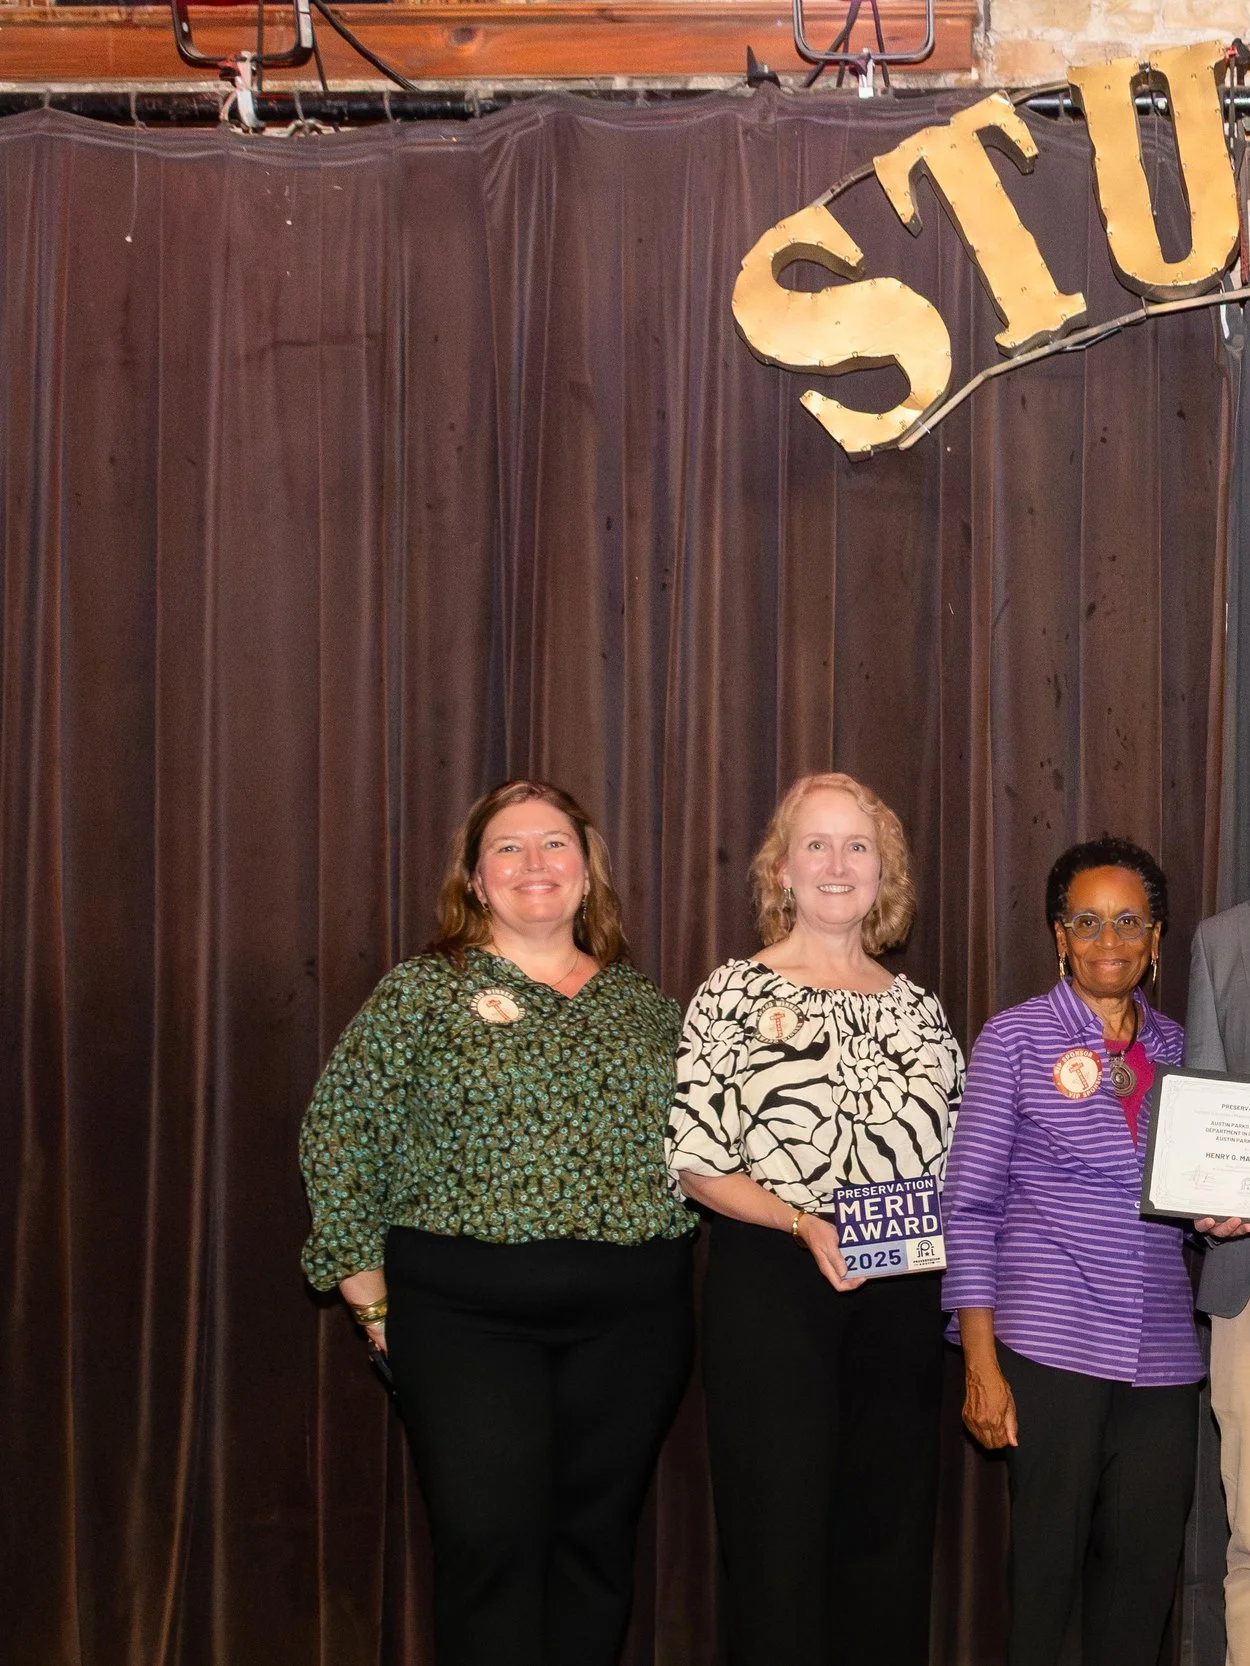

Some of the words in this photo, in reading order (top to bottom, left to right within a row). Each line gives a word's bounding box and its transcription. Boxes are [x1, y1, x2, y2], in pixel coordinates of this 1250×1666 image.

[1061, 1049, 1094, 1063] SPONSOR
[1068, 1091, 1081, 1099] VIP
[1082, 1070, 1103, 1098] SPONSOR
[1205, 1127, 1241, 1136] DEPARTMENT
[1210, 1120, 1231, 1128] AUSTIN
[1230, 1122, 1250, 1130] PARKS
[1205, 1152, 1230, 1160] HENRY
[837, 1179, 934, 1200] PRESERVATION
[839, 1190, 934, 1224] MERIT
[841, 1215, 938, 1244] AWARD
[844, 1249, 902, 1272] 2025
